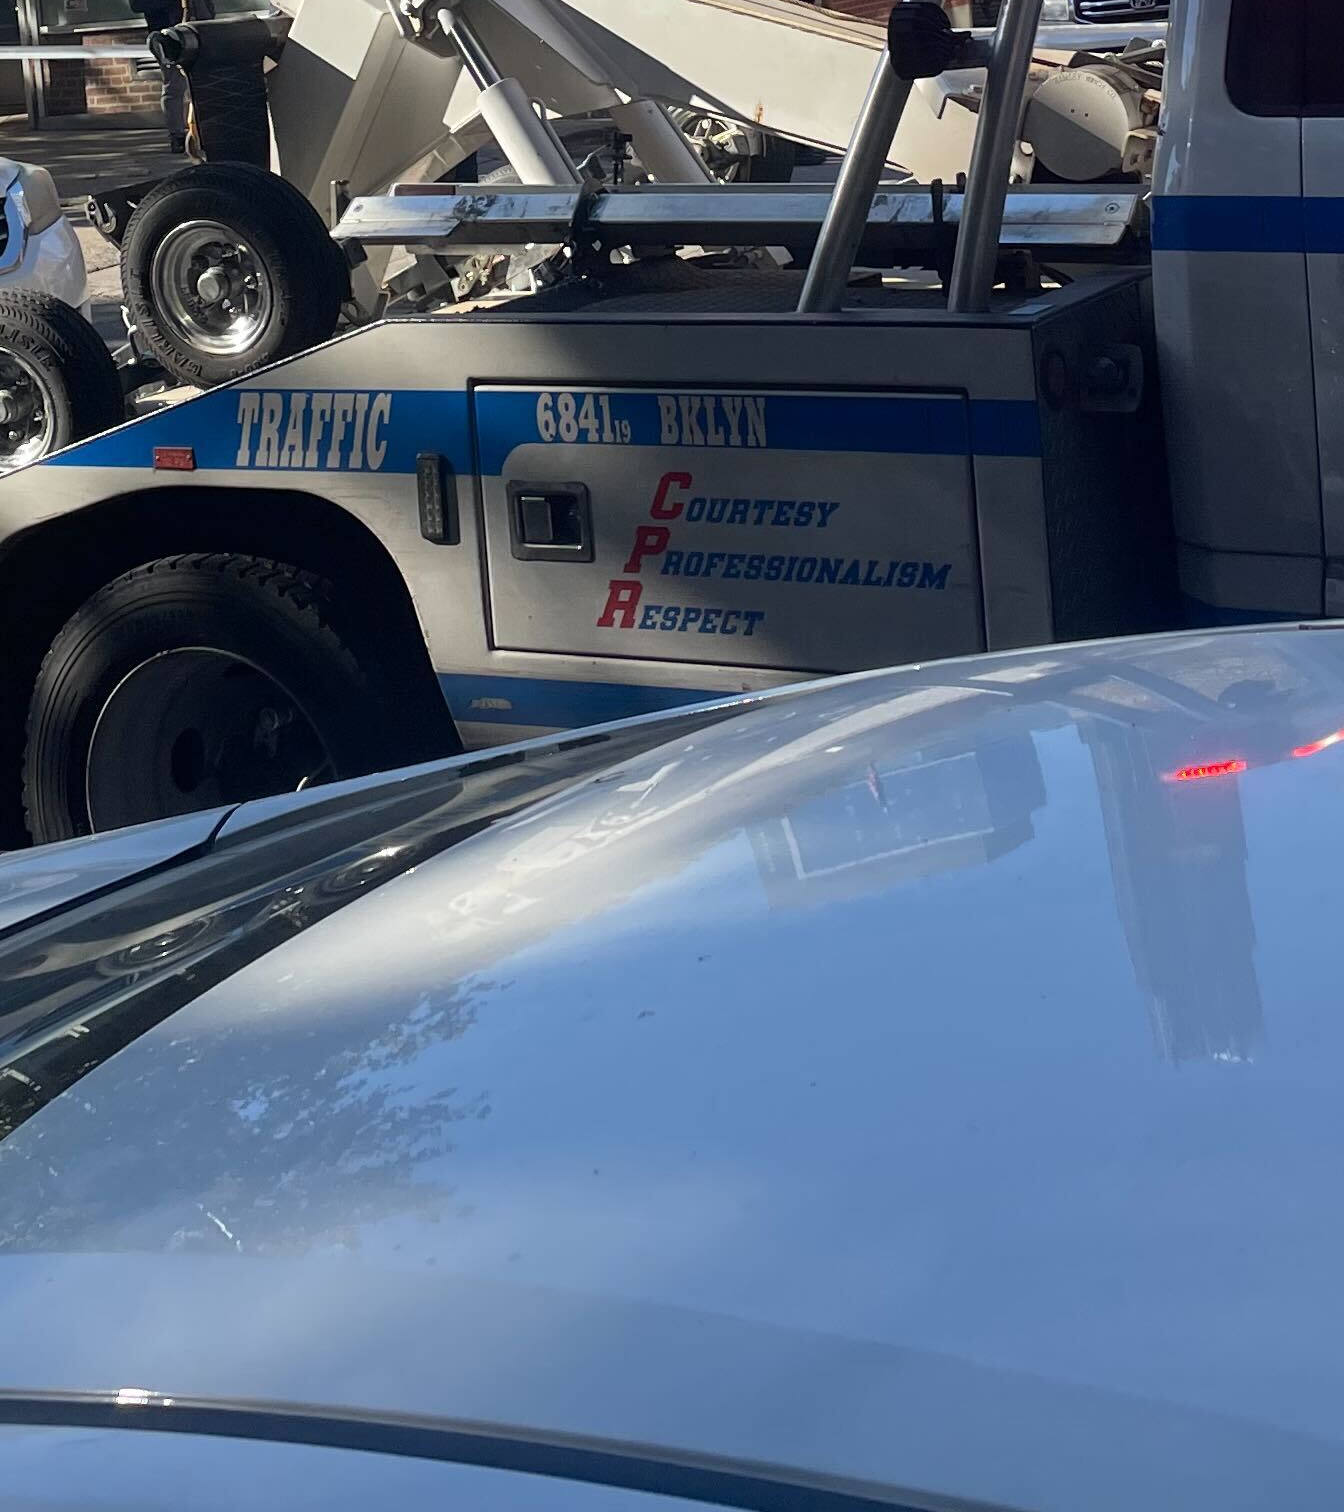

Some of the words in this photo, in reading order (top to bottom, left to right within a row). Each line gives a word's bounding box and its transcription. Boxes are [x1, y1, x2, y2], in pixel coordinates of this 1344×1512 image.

[235, 392, 393, 471] TRAFFIC
[658, 395, 767, 447] BKLYN
[650, 471, 840, 528] COURTESY
[623, 525, 952, 590] PROFESSIONALISM
[596, 579, 765, 636] RESPECT
